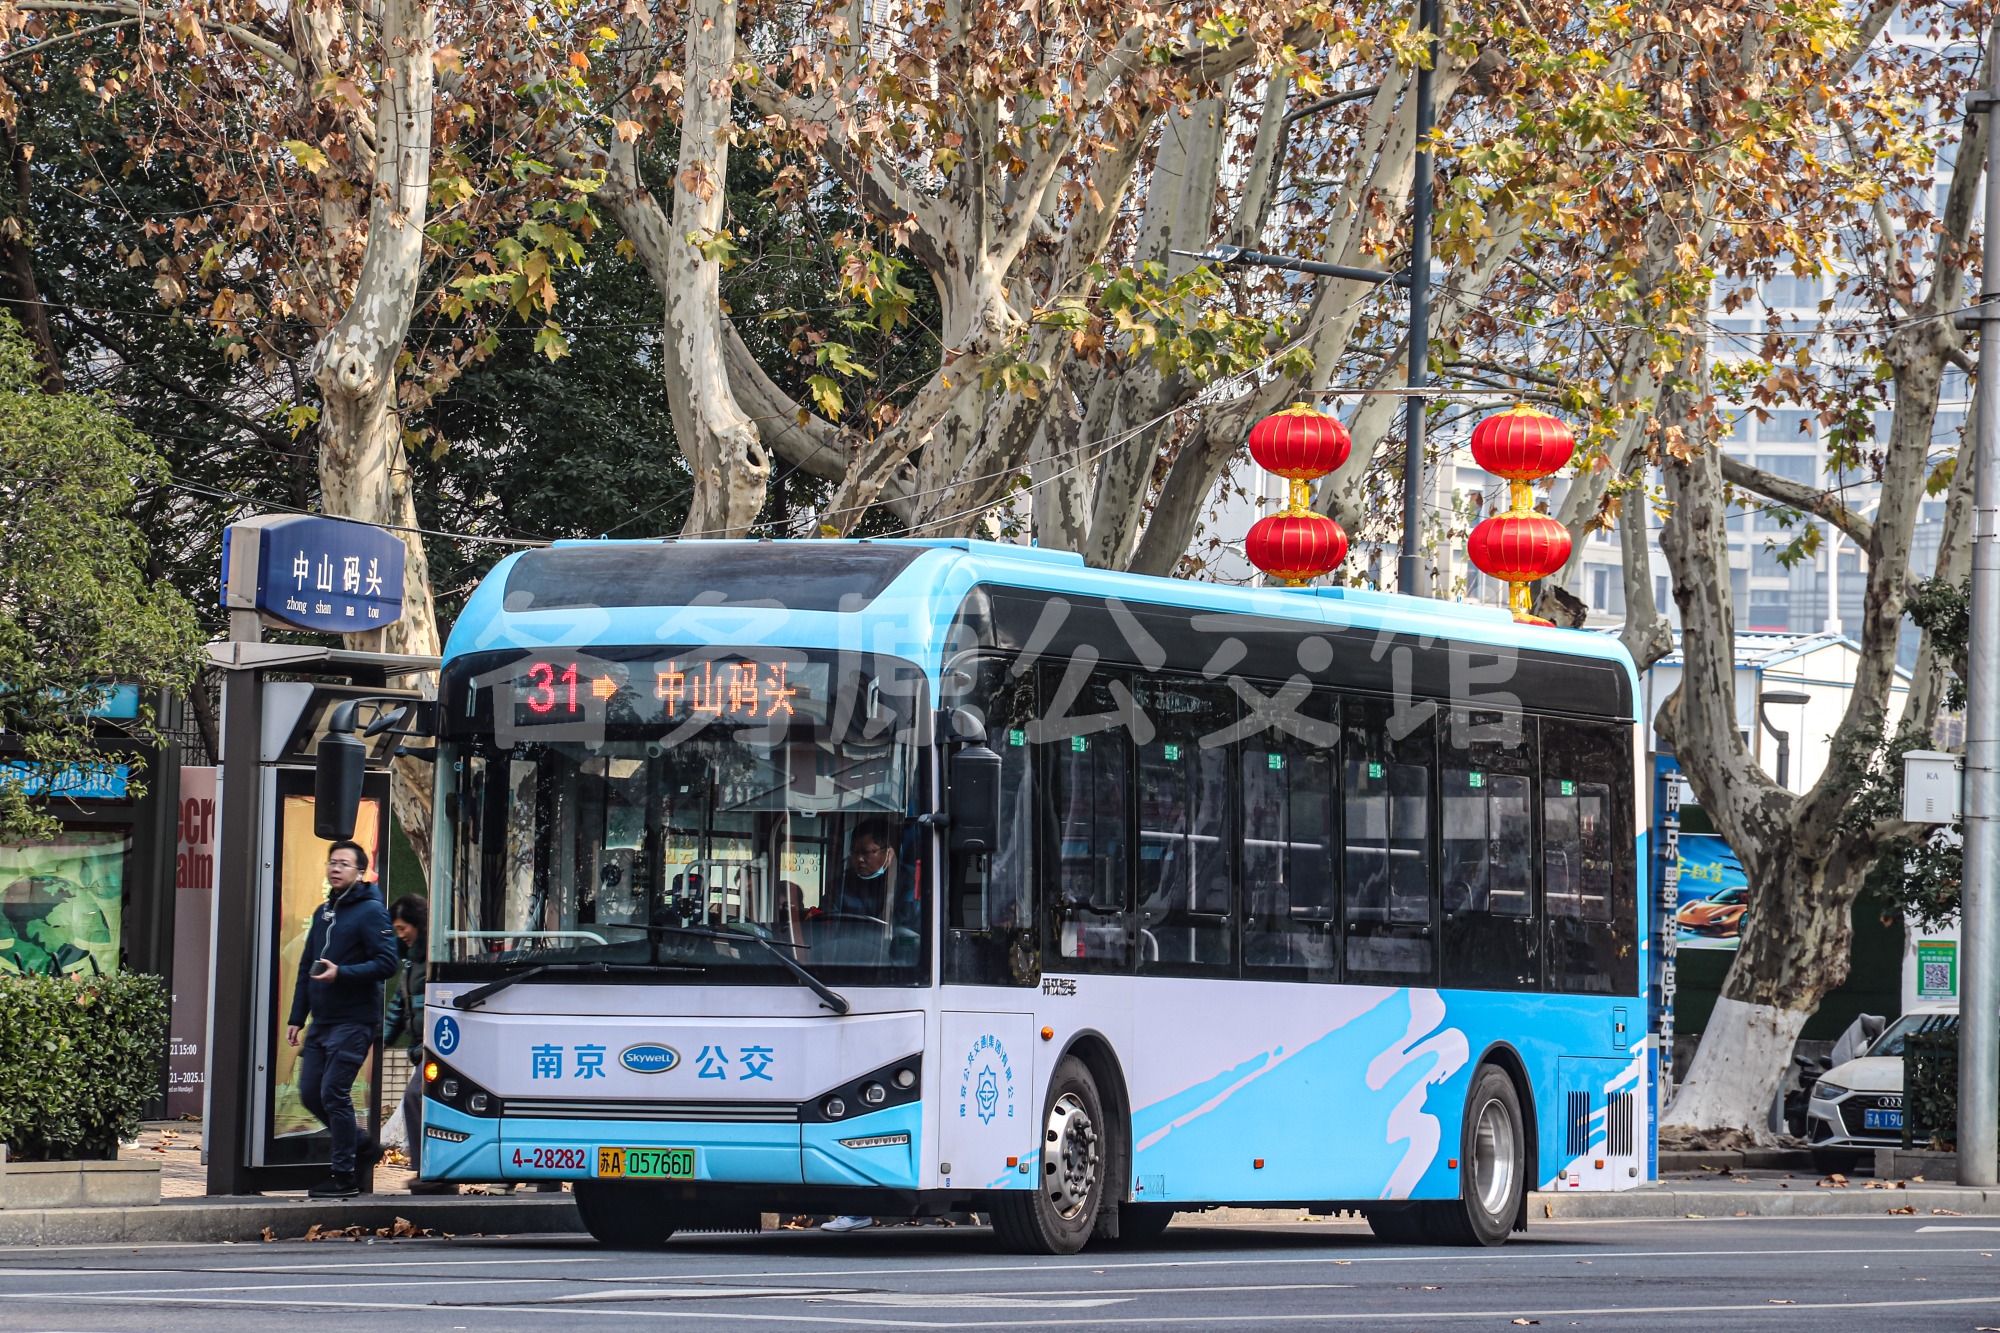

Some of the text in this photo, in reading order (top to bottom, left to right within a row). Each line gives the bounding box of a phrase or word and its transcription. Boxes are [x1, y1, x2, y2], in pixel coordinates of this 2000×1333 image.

[293, 550, 382, 596] 中山码头
[287, 596, 379, 618] zhong shan ma tou
[528, 662, 578, 713] 31
[657, 661, 796, 717] 中山码头
[180, 1044, 197, 1055] 15:00
[531, 1043, 774, 1081] 南京 公交
[626, 1053, 671, 1064] Skywell
[512, 1148, 586, 1169] 4-28282
